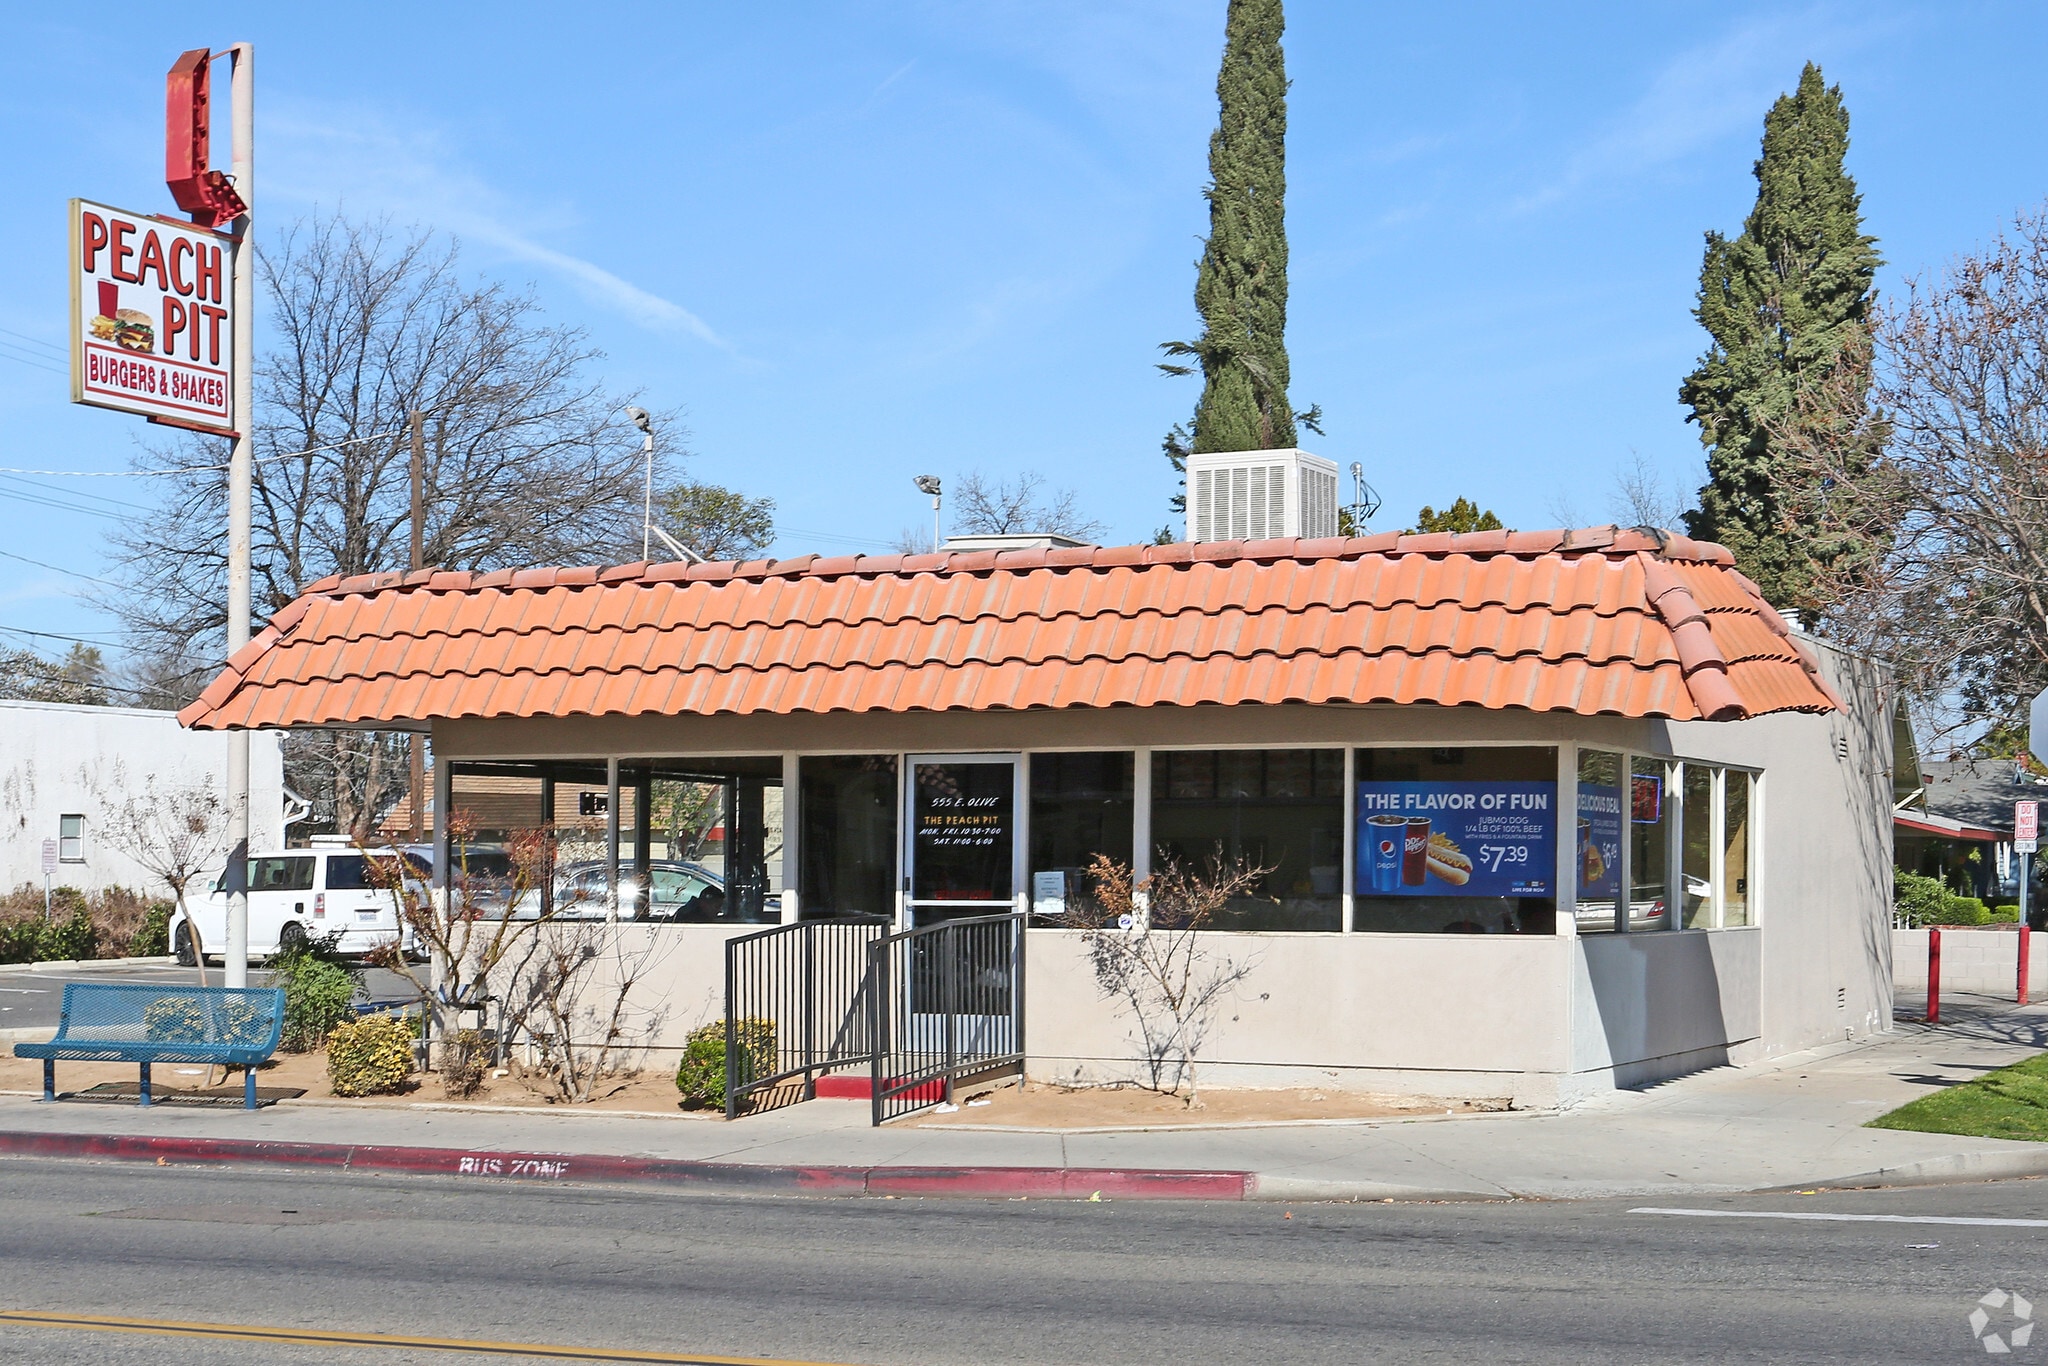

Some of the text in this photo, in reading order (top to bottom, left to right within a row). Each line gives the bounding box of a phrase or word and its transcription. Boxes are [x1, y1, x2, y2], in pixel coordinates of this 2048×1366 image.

[83, 211, 222, 304] PEACH
[163, 295, 227, 365] PIT
[90, 353, 223, 407] BURGERS & SHAKES
[931, 797, 953, 807] 555
[967, 796, 999, 807] OLIVE
[1364, 794, 1547, 810] THE FLAVOR OF FUN
[1606, 797, 1620, 814] DEAL
[2021, 805, 2032, 814] DO
[924, 816, 999, 825] THE PEACH PIT
[1509, 816, 1529, 825] DOG
[2020, 816, 2033, 825] NOT
[1465, 825, 1543, 833] 1/4 LB OF 100% BEEF
[1479, 844, 1528, 873] $7.39
[1376, 861, 1397, 870] pepsi
[459, 1156, 503, 1176] BUS
